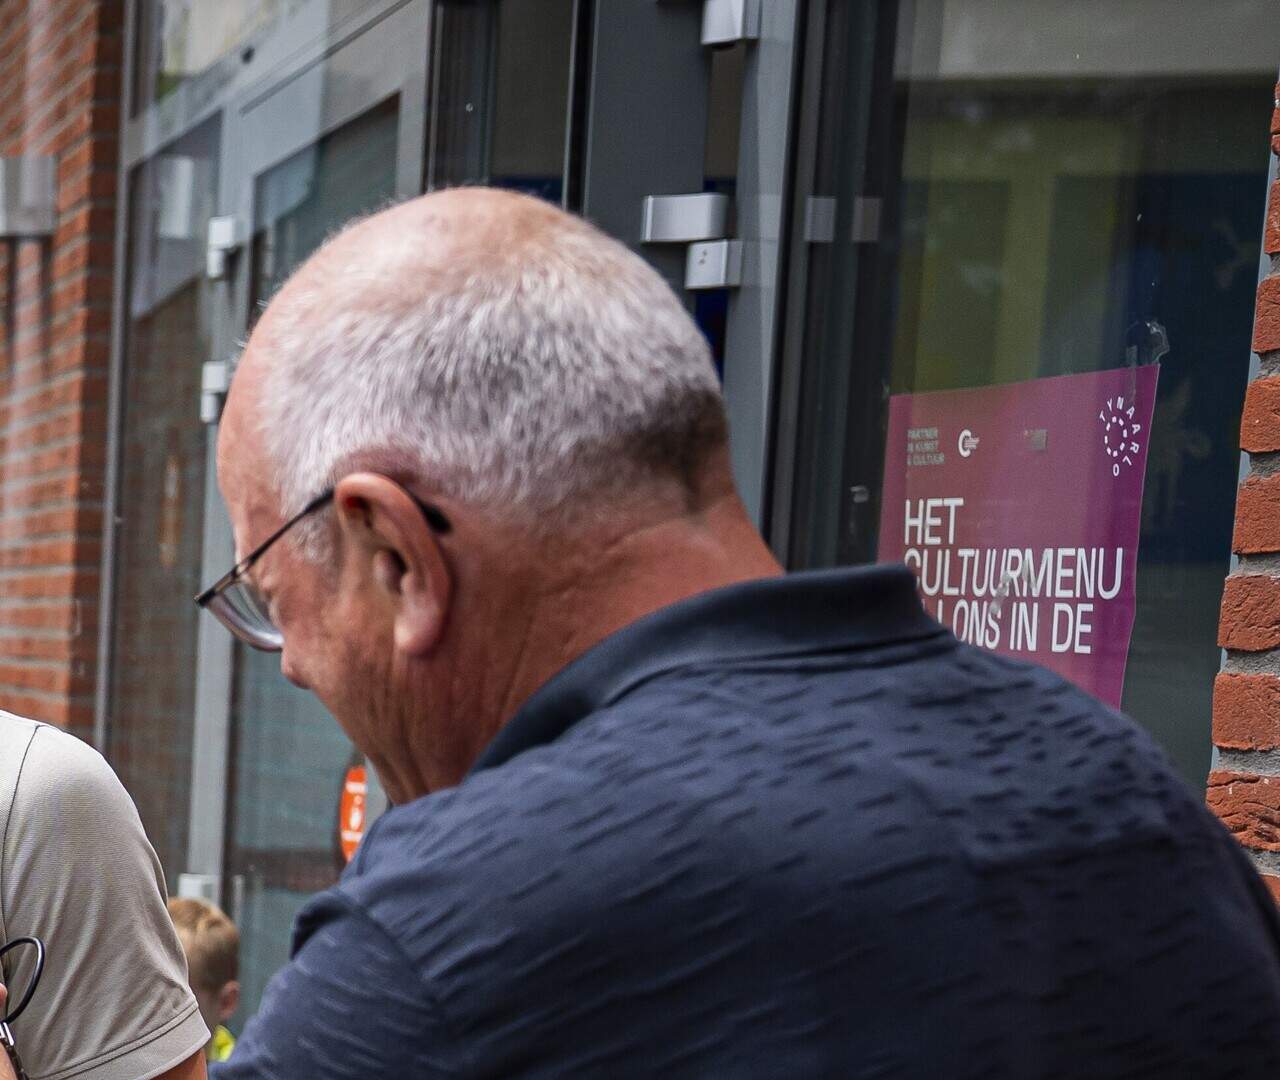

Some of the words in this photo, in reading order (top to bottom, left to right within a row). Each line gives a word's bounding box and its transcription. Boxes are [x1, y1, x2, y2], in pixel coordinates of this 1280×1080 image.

[1099, 396, 1141, 475] TYNAARLO
[904, 498, 964, 545] HET
[952, 599, 1002, 650] ONS
[1009, 602, 1038, 651] IN
[1051, 603, 1094, 654] DE
